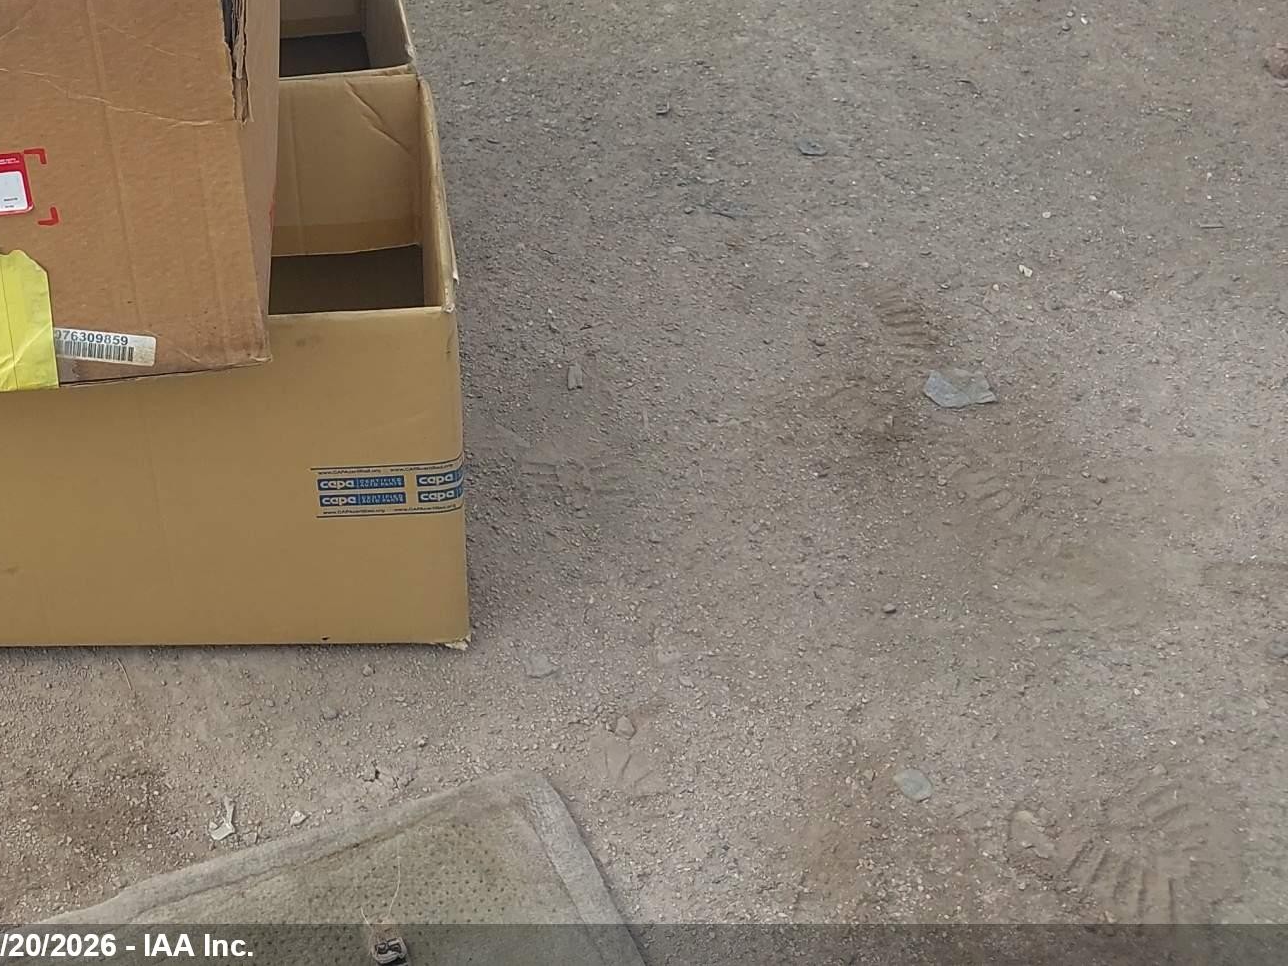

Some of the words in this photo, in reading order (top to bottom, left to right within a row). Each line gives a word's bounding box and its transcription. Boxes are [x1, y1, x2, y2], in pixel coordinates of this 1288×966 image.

[320, 479, 354, 489] capa
[419, 473, 453, 485] capa
[322, 496, 356, 505] capa
[420, 490, 454, 501] capa
